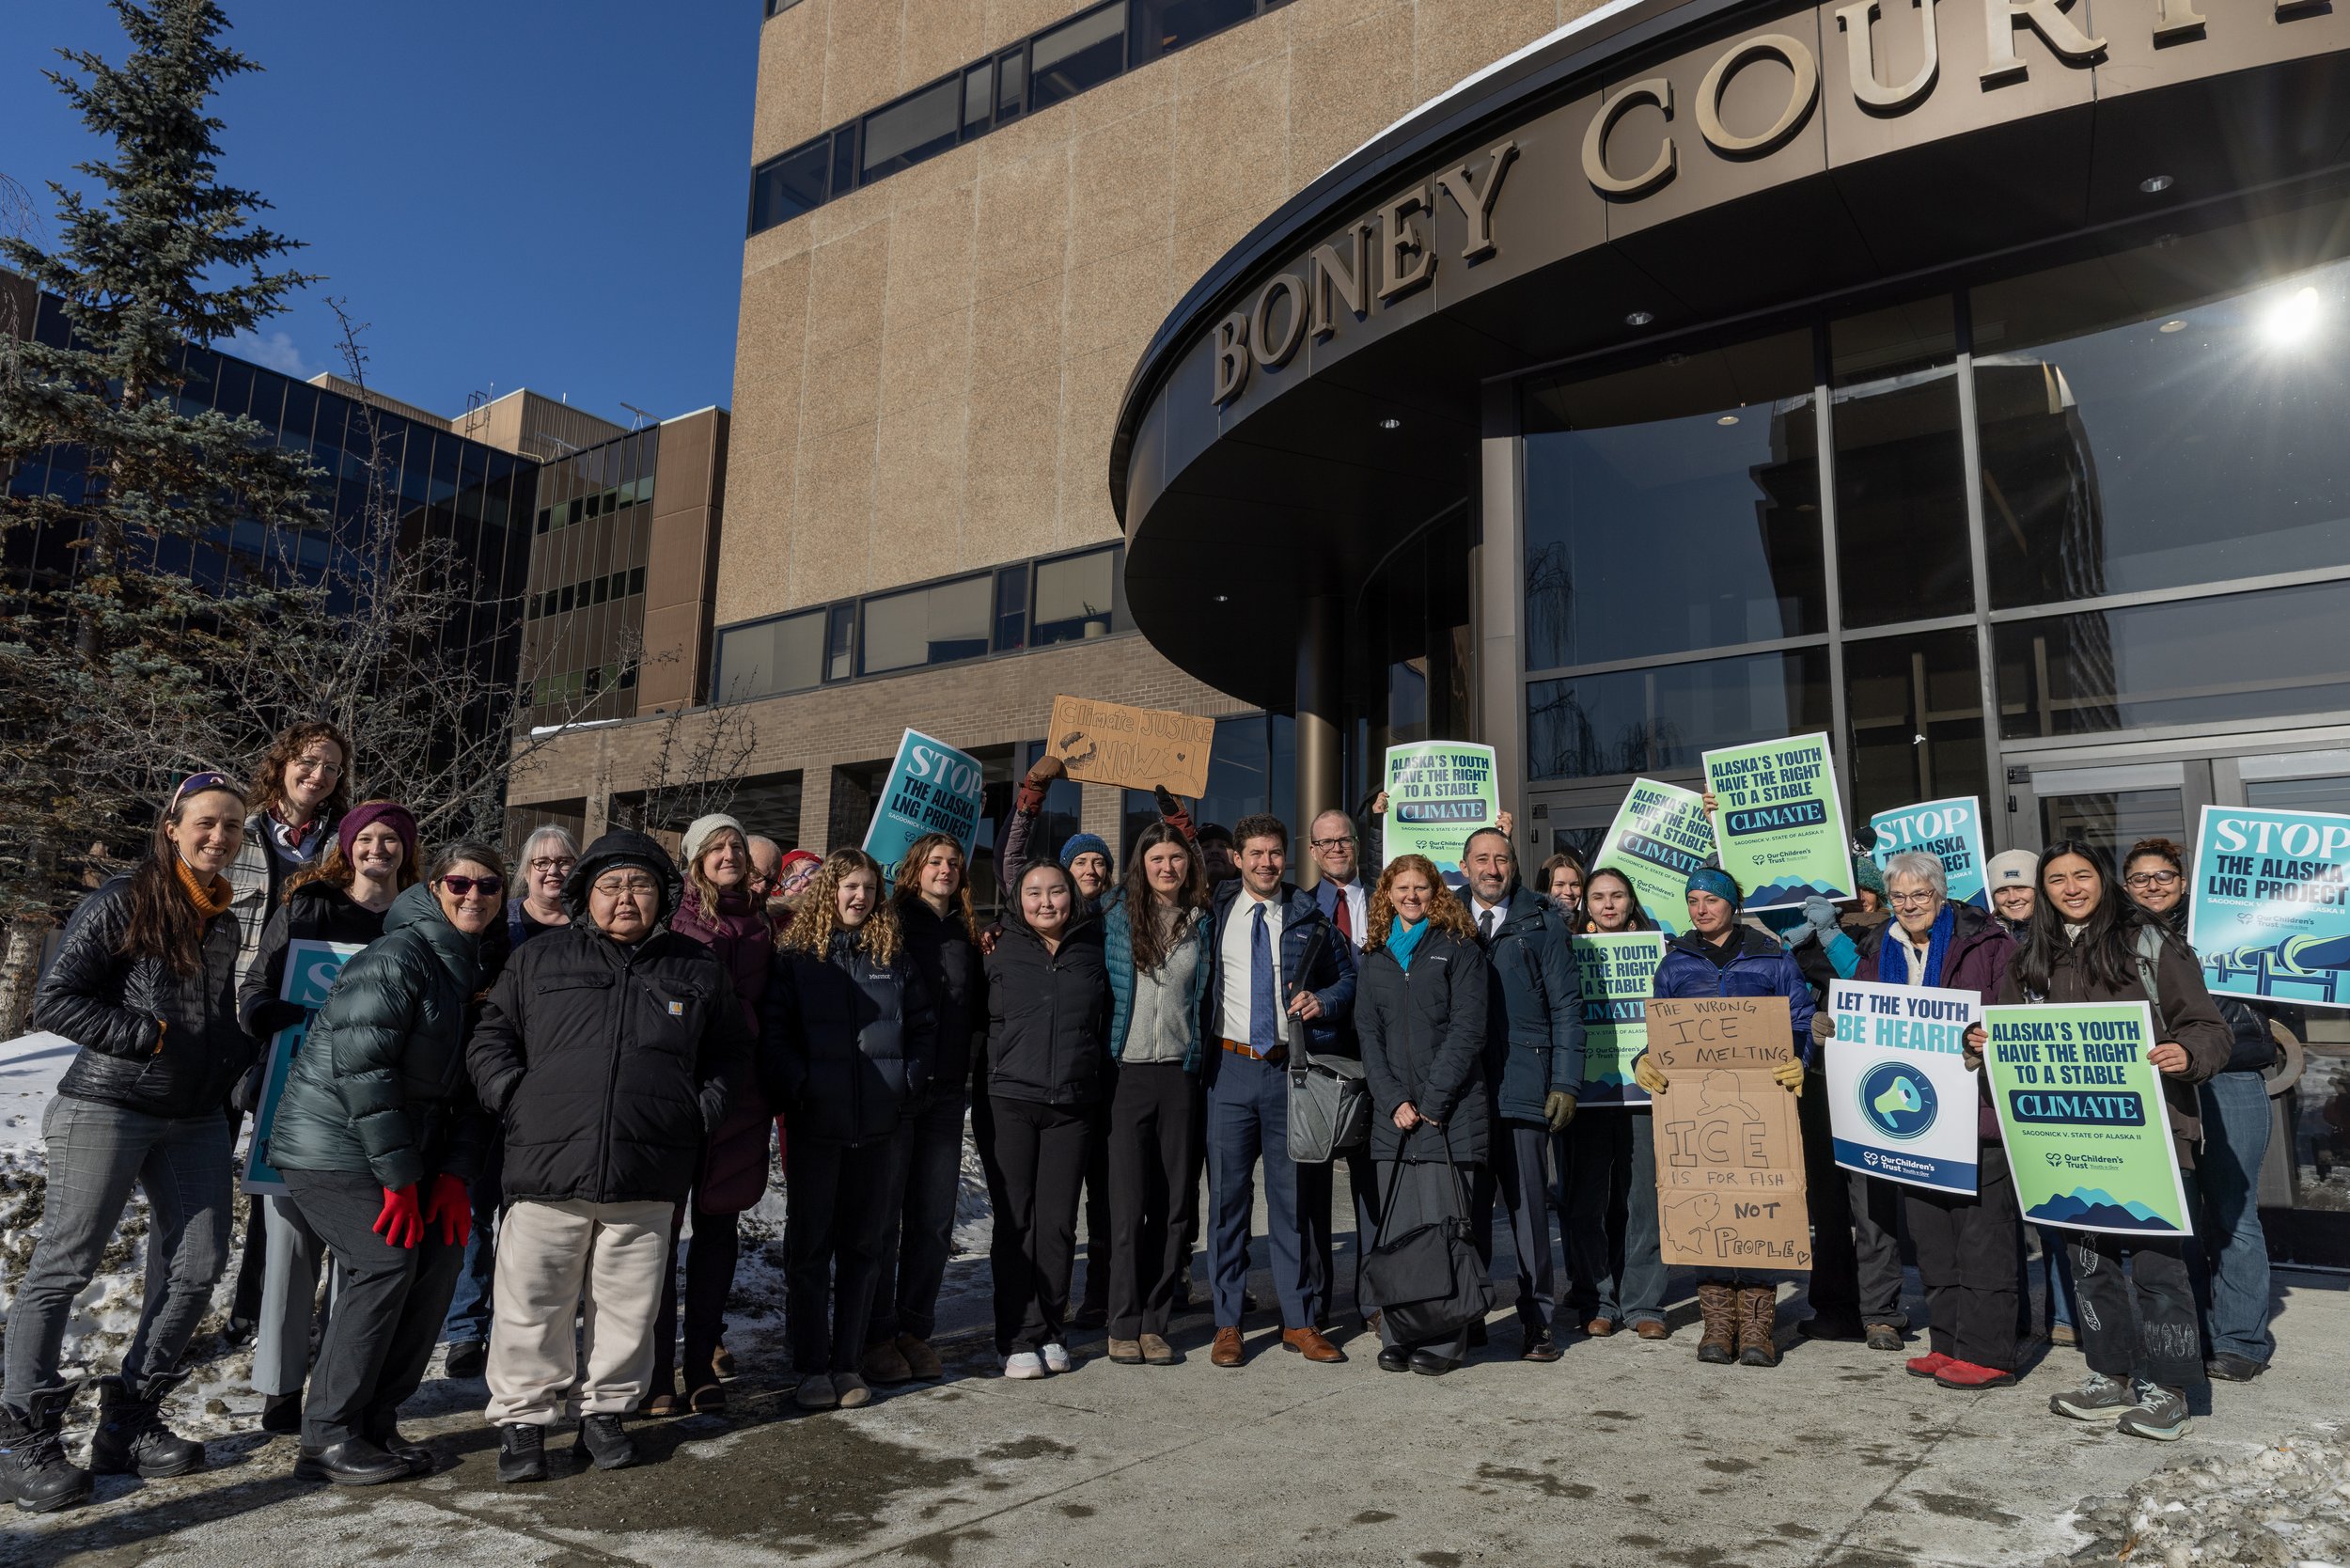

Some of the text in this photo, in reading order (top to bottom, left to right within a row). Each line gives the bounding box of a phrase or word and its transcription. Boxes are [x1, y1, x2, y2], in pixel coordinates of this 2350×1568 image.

[1212, 0, 2331, 406] BONEY COUR
[1059, 700, 1214, 745] Climate JUSTICE
[1093, 740, 1161, 780] NOW
[1391, 755, 1490, 771] ALASKA'S YOUTH
[1712, 746, 1823, 778] ALASKA'S YOUTH
[905, 745, 982, 799] STOP
[1393, 769, 1487, 783] HAVE THE RIGHT
[1716, 763, 1821, 792] HAVE THE RIGHT
[903, 776, 974, 822] THE ALASKA
[1403, 783, 1479, 797] TO A STABLE
[1729, 781, 1812, 807] TO A STABLE
[1402, 802, 1482, 819] CLIMATE
[1633, 789, 1688, 815] ALASKA'S
[887, 811, 920, 829] SAGOONICK
[891, 793, 972, 840] LNG PROJECT
[1629, 801, 1661, 821] HAVE
[1662, 810, 1685, 830] THE
[1731, 803, 1822, 831] CLIMATE
[1635, 816, 1708, 854] TO A STABLE
[1874, 808, 1969, 851] STOP
[2214, 818, 2350, 859] STOP
[1623, 834, 1703, 872] CLIMATE
[1779, 848, 1811, 857] Children's
[1940, 852, 1970, 873] JECT
[1617, 855, 1644, 870] SAGOONICK
[1650, 868, 1664, 877] STATE
[1671, 876, 1687, 885] ALASK
[1947, 871, 1967, 881] ALASKA
[2217, 855, 2343, 883] THE ALASKA
[1636, 884, 1651, 894] Trust
[1637, 879, 1648, 887] Our
[1648, 883, 1675, 898] Children's
[2208, 875, 2349, 906] LNG PROJECT
[2207, 897, 2255, 908] SAGOONICK
[2310, 906, 2339, 915] LASKA
[2273, 916, 2314, 926] Children's
[1612, 945, 1658, 961] YOUTH
[1587, 964, 1612, 979] THE
[1617, 962, 1656, 978] RIGHT
[1585, 979, 1647, 995] A STABLE
[1584, 1001, 1645, 1020] IMAT
[1650, 1000, 1757, 1018] THE WRONG
[1837, 991, 1969, 1022] LET THE YOUTH
[1669, 1017, 1738, 1045] ICE
[1837, 1013, 1965, 1055] BE HEARD
[1992, 1021, 2140, 1042] ALASKA'S YOUTH
[1658, 1046, 1788, 1065] IS MELTING
[1997, 1043, 2138, 1063] HAVE THE RIGHT
[2014, 1065, 2126, 1085] TO A STABLE
[2016, 1094, 2138, 1120] CLIMATE
[1665, 1120, 1769, 1168] ICE
[1880, 1154, 1935, 1172] Our Children's
[1881, 1162, 1902, 1172] Trust
[2064, 1153, 2123, 1164] Our Children's
[2066, 1161, 2089, 1169] Trust
[1671, 1171, 1784, 1186] IS FOR FISH
[1734, 1202, 1780, 1219] NOT
[1715, 1227, 1794, 1258] PEOPLE
